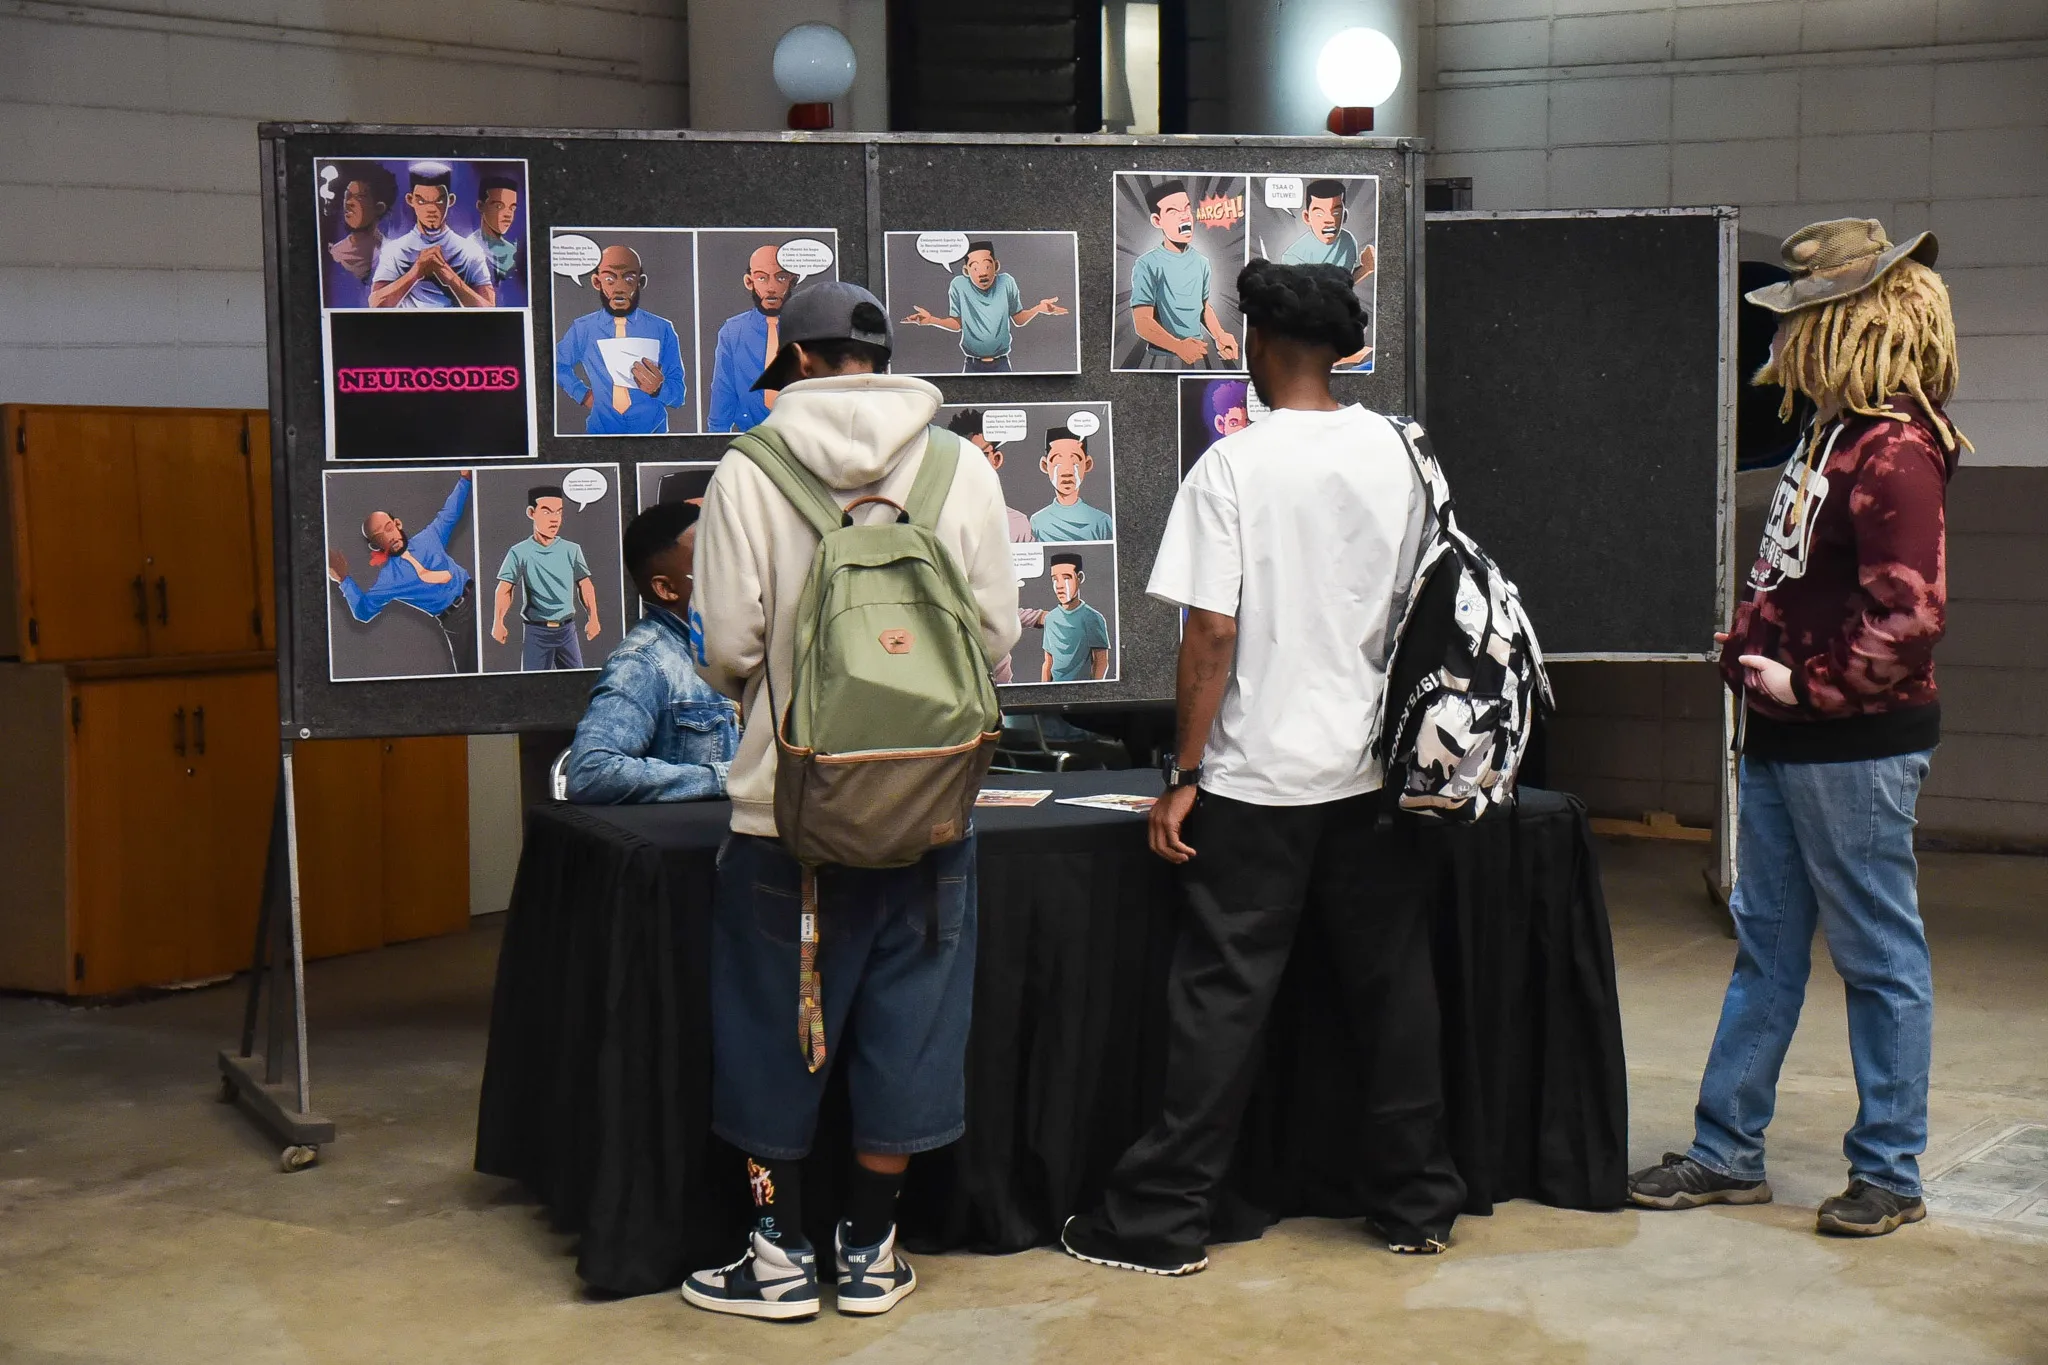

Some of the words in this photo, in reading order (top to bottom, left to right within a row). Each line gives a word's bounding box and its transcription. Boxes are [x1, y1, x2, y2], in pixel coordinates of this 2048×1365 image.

[1196, 195, 1245, 221] AARGH!
[339, 367, 519, 392] NEUROSODES
[848, 1254, 867, 1264] NIKE
